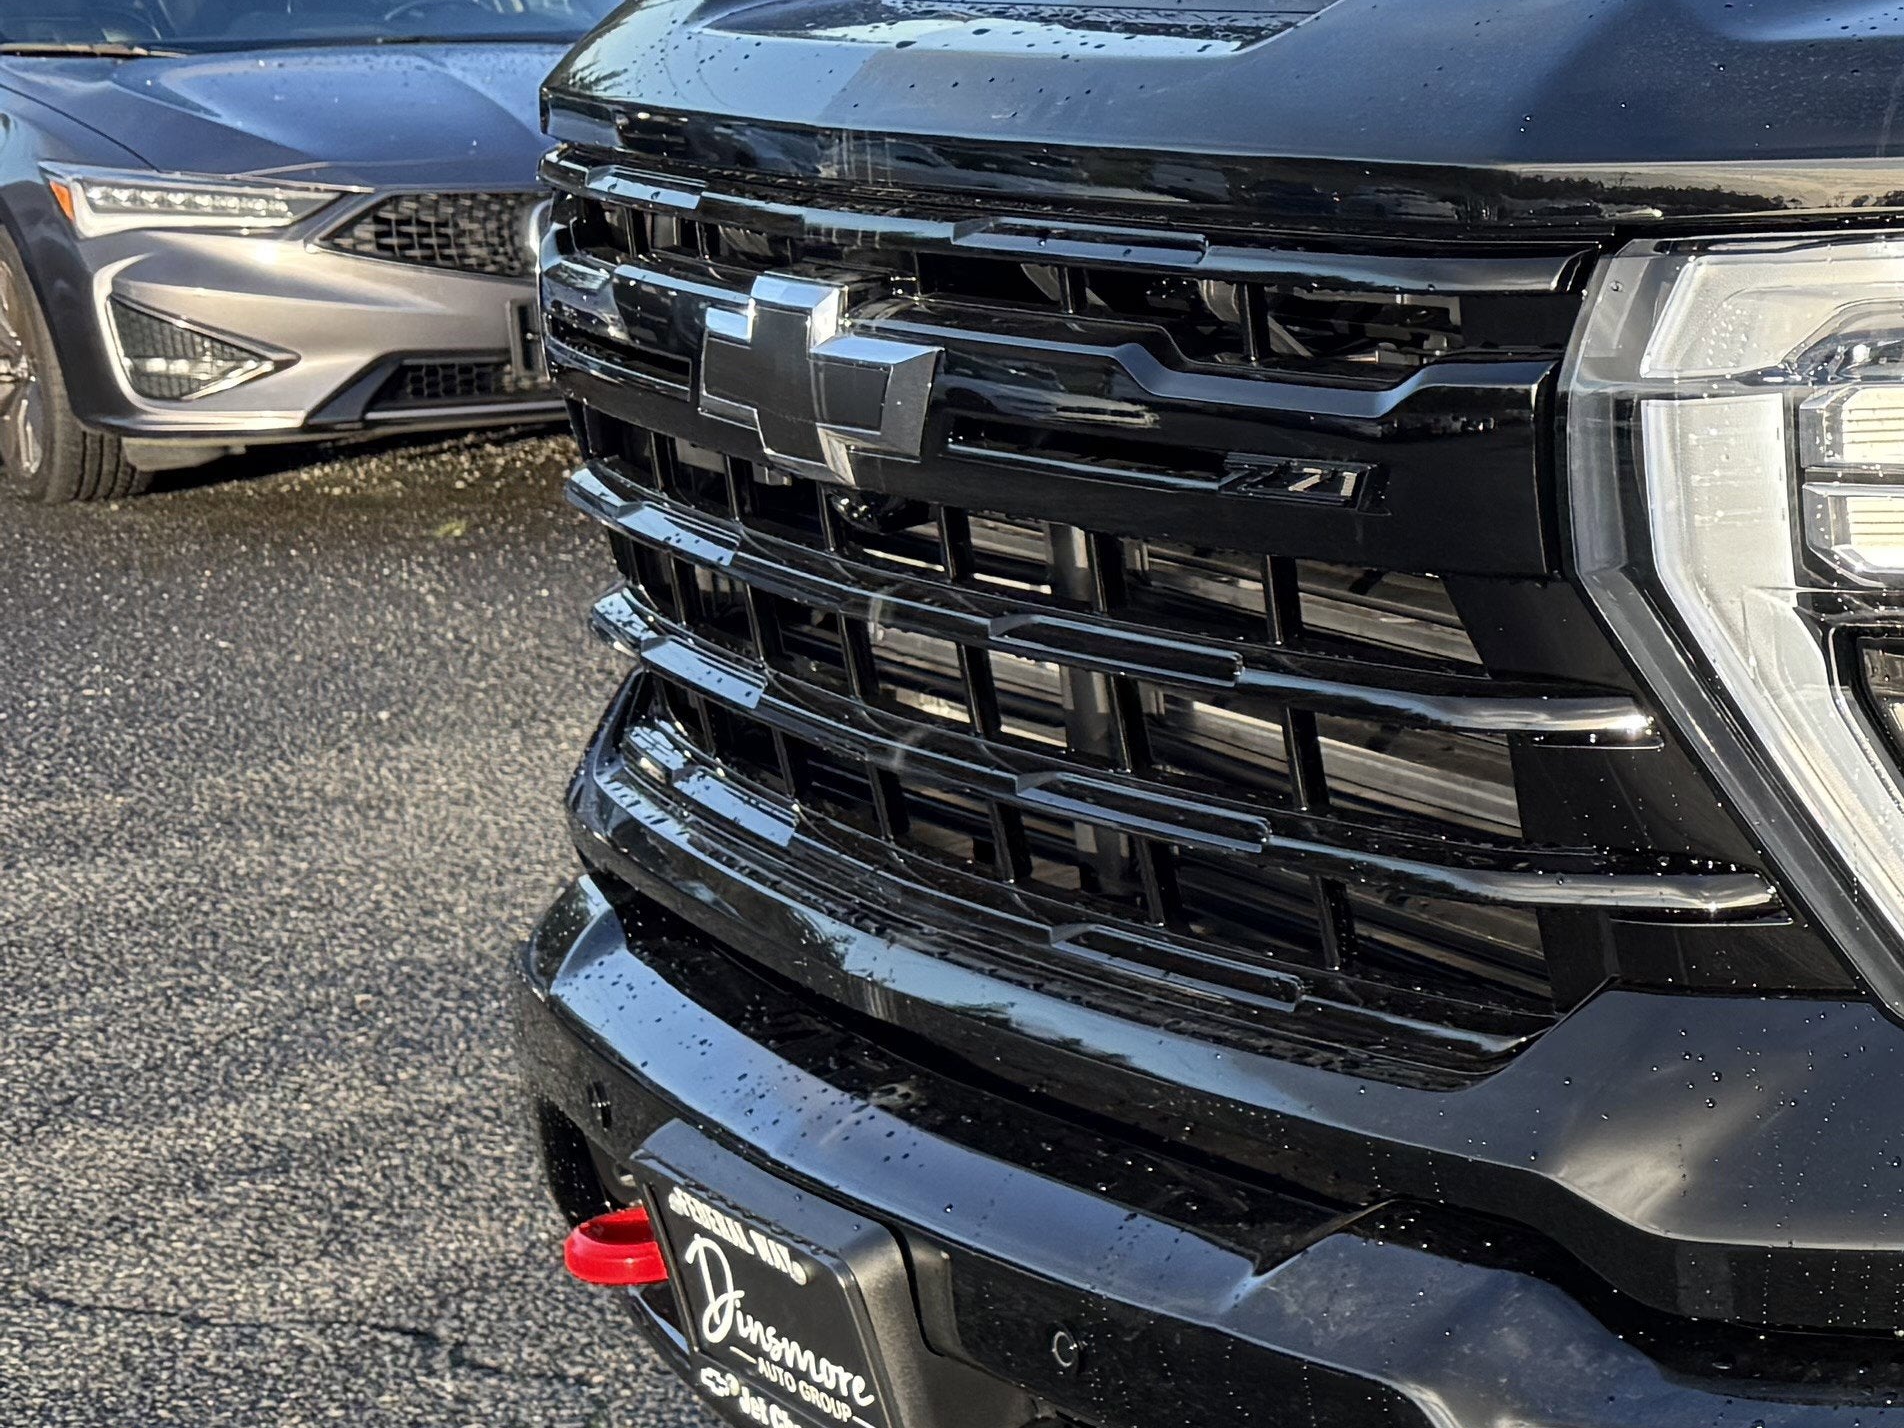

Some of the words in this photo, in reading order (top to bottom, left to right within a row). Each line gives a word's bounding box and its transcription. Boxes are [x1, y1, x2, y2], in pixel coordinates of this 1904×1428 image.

[1218, 452, 1376, 510] Z71
[685, 1232, 875, 1407] Dinsmore
[738, 1385, 770, 1426] Jet
[757, 1356, 797, 1393] AUTO
[798, 1379, 853, 1423] GROUP
